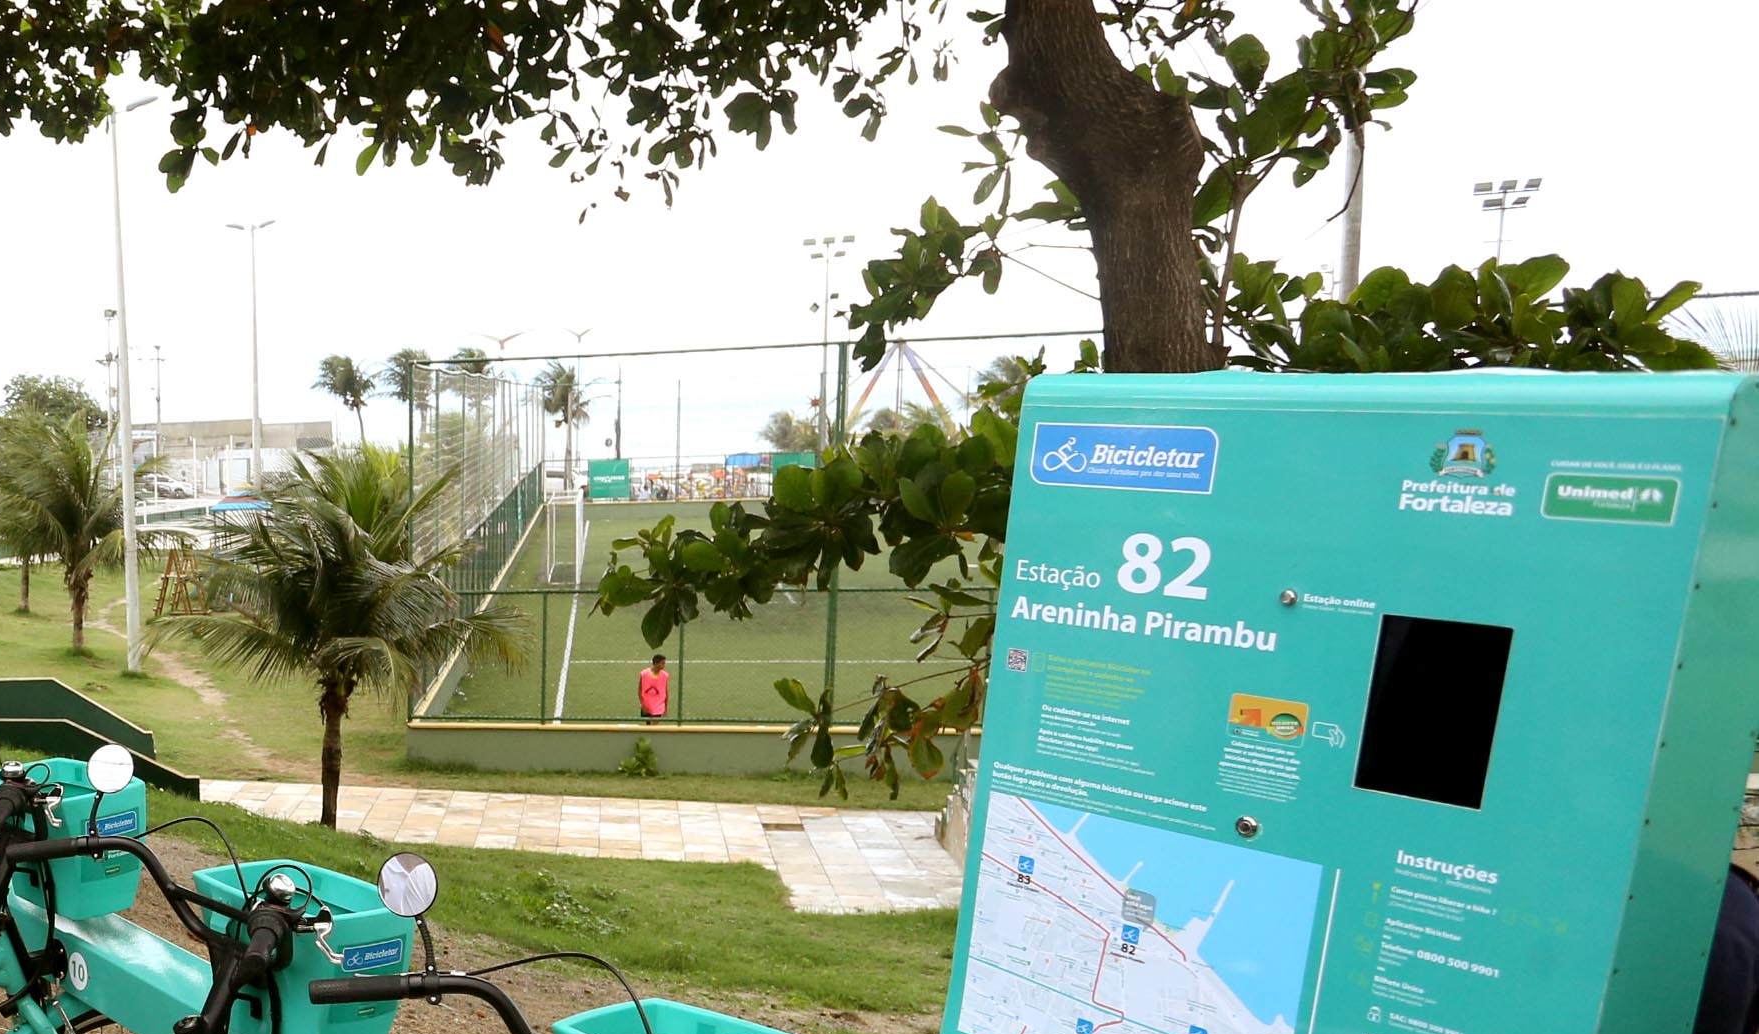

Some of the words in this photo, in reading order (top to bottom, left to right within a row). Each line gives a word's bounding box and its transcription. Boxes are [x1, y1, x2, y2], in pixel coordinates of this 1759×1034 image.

[1090, 443, 1205, 469] Bicicletar
[1402, 479, 1488, 496] Prefeitura
[1493, 484, 1516, 497] de
[1557, 485, 1634, 500] Unimed
[1399, 492, 1514, 517] Fortaleza
[1016, 559, 1101, 590] Estação
[1117, 533, 1211, 600] 82
[1304, 593, 1341, 606] Estação
[1343, 599, 1376, 609] online
[1011, 596, 1137, 634] Areninha
[1144, 610, 1278, 652] Pirambu
[993, 761, 1025, 775] Qualquer
[1025, 767, 1058, 782] problema
[1059, 774, 1073, 784] com
[1074, 777, 1101, 792] alguma
[1101, 782, 1131, 797] bicicleta
[1132, 790, 1143, 799] ou
[1144, 792, 1163, 804] vaga
[1190, 802, 1207, 812] este
[1013, 774, 1028, 785] logo
[1028, 776, 1046, 789] após
[104, 818, 134, 831] Bicicletar
[1396, 849, 1498, 885] Instruções
[1017, 873, 1031, 885] 83
[364, 947, 399, 961] Bicicletar
[1121, 943, 1136, 956] 82
[71, 960, 85, 982] 10
[1416, 949, 1445, 965] 0800
[1446, 957, 1469, 970] 500
[1470, 963, 1499, 978] 9901
